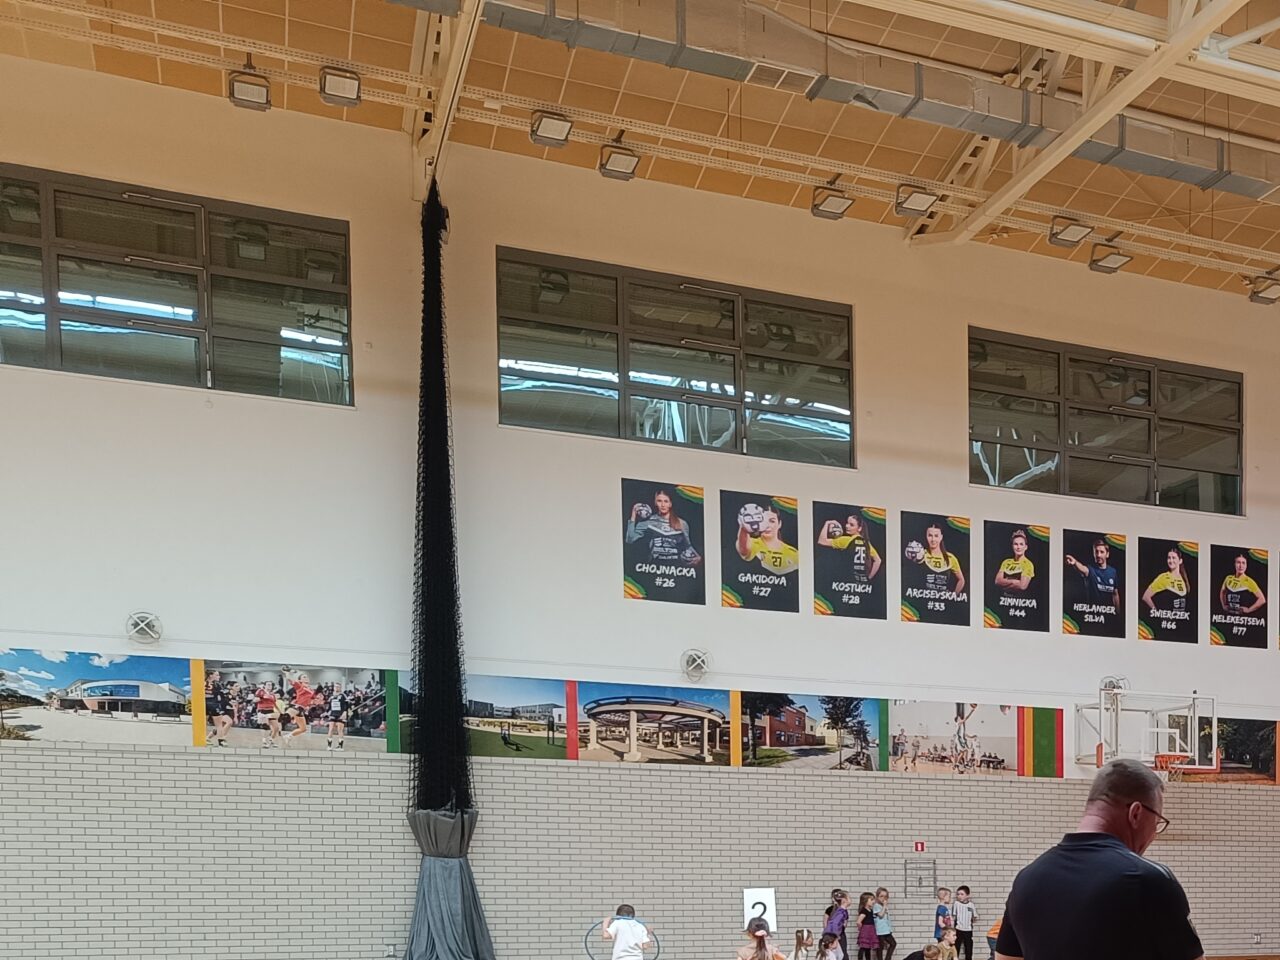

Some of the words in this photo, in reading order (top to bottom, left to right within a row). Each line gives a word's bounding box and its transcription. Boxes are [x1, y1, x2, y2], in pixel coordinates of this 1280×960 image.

[635, 563, 696, 578] CHOJNACKA
[655, 577, 676, 588] #26
[738, 573, 787, 586] GAKIDOVA
[752, 585, 771, 597] #27
[831, 581, 872, 594] KOSTUCH
[842, 593, 860, 604] #28
[906, 587, 967, 602] ARCISEVSKAJA
[927, 600, 945, 611] #33
[999, 597, 1037, 608] ZIMNICKA
[1008, 608, 1026, 617] #44
[1073, 603, 1116, 615] HERLANDER
[1084, 614, 1104, 624] SILVA
[1161, 620, 1177, 630] #66
[1232, 626, 1247, 636] #77
